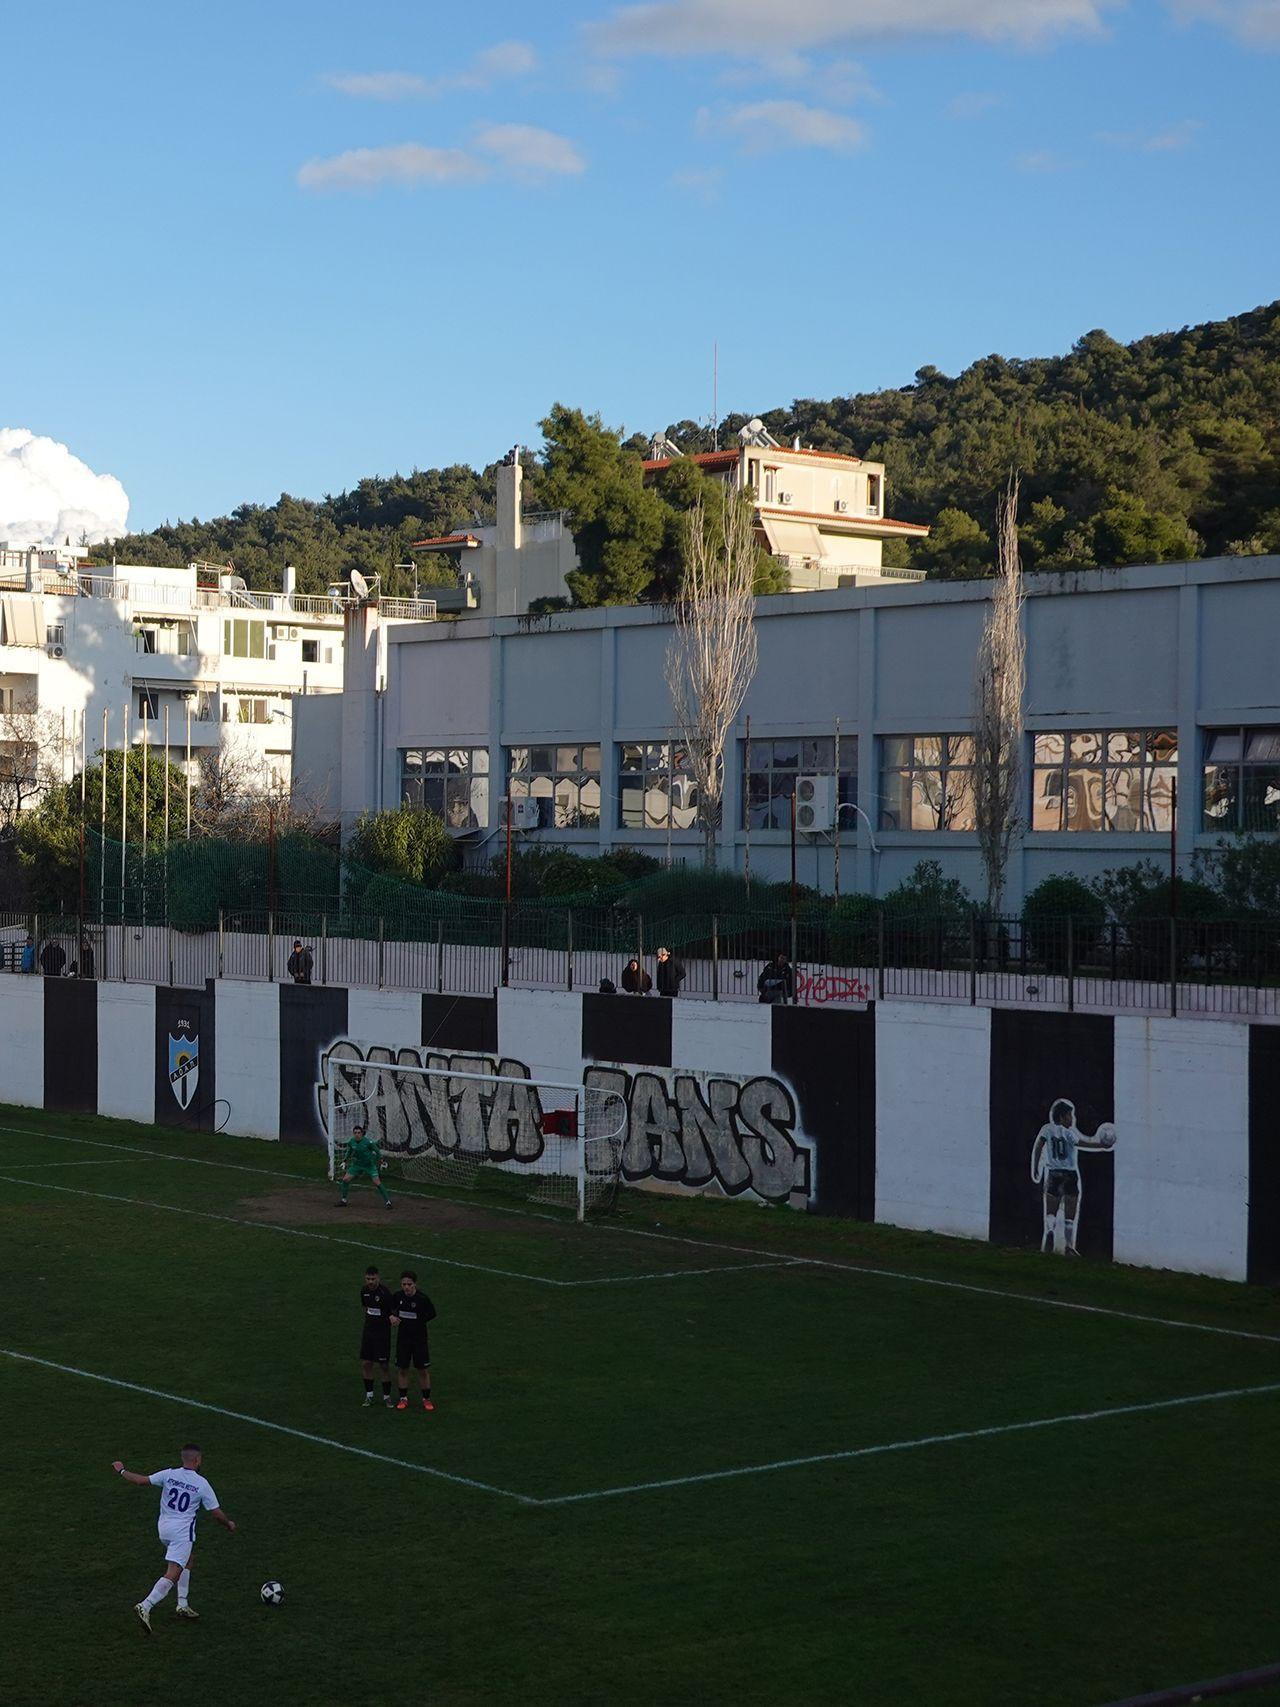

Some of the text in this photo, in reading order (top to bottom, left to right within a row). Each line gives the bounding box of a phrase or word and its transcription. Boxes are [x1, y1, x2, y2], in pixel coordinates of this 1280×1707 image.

[318, 1041, 545, 1163] SANTA
[1052, 1136, 1068, 1161] 10
[168, 1488, 190, 1512] 20
